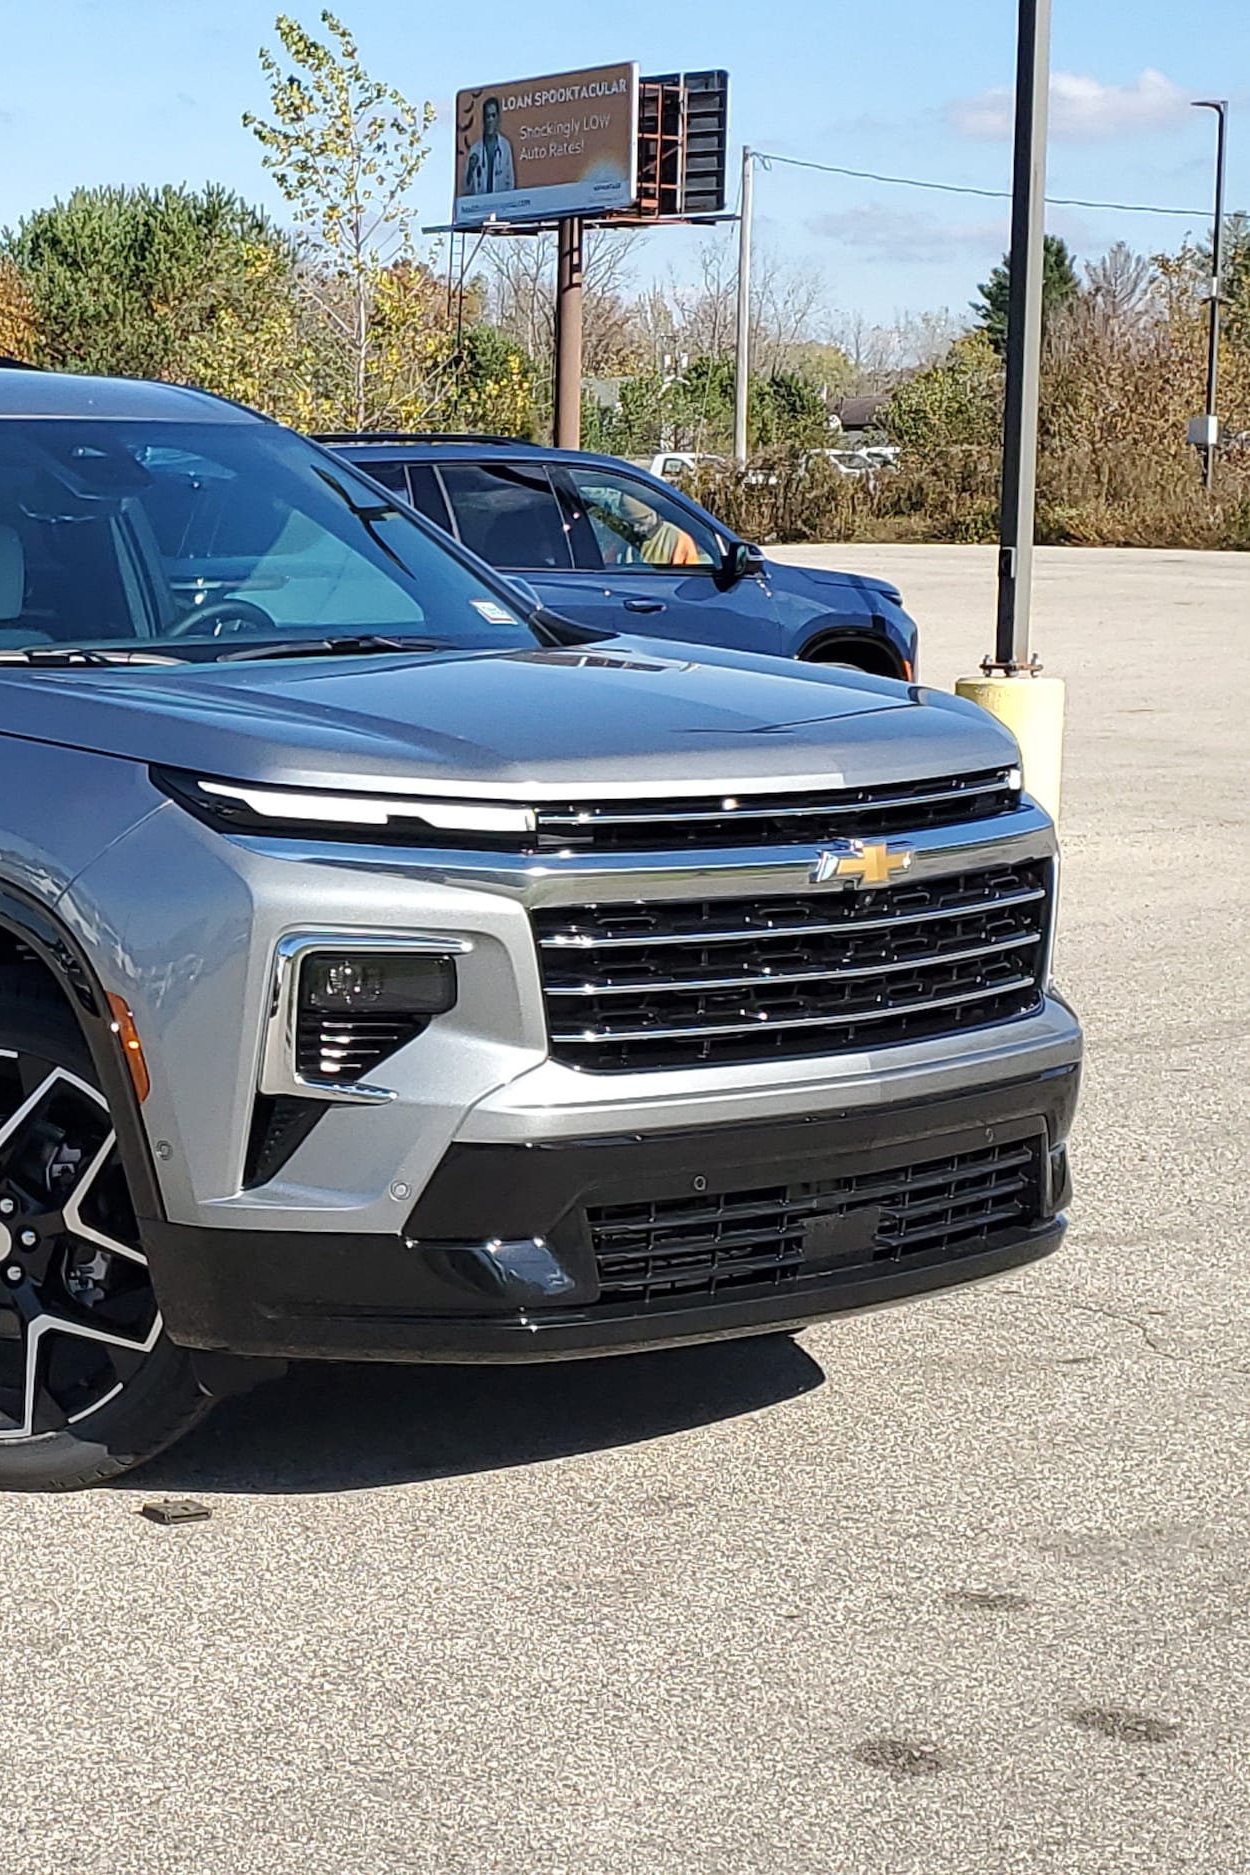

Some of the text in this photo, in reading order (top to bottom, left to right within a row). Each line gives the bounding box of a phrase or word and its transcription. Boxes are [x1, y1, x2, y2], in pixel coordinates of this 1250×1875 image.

[501, 79, 627, 111] LOAN SPOOKTACULAR
[519, 114, 611, 139] Shockingly LOW
[519, 140, 585, 160] Auto Rates!
